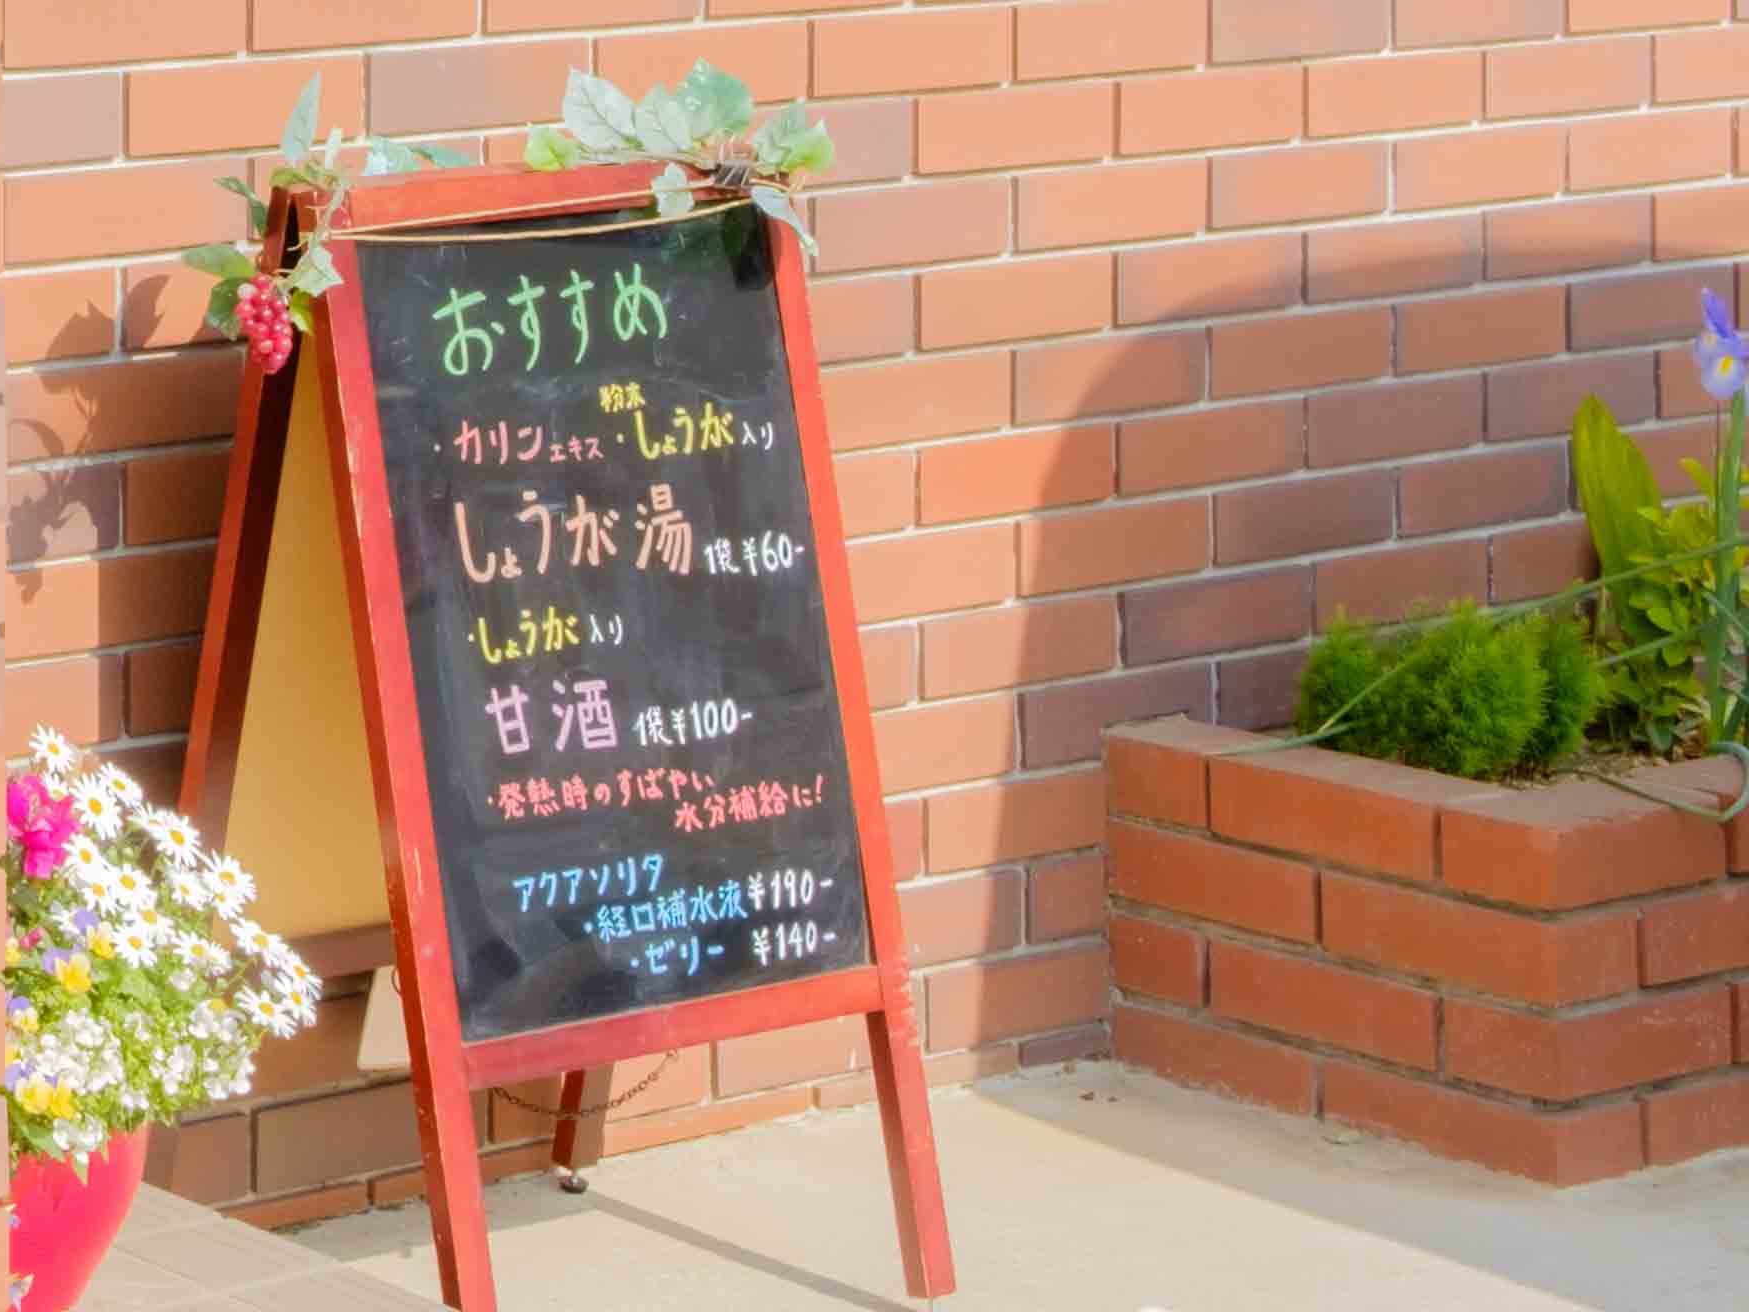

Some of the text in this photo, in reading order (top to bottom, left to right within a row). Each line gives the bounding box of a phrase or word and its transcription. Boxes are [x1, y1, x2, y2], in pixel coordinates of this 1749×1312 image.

[432, 263, 667, 376] おすすめ
[455, 483, 693, 582] しょうが湯
[484, 678, 619, 755] 甘酒
[512, 852, 665, 914] アクアソリタ
